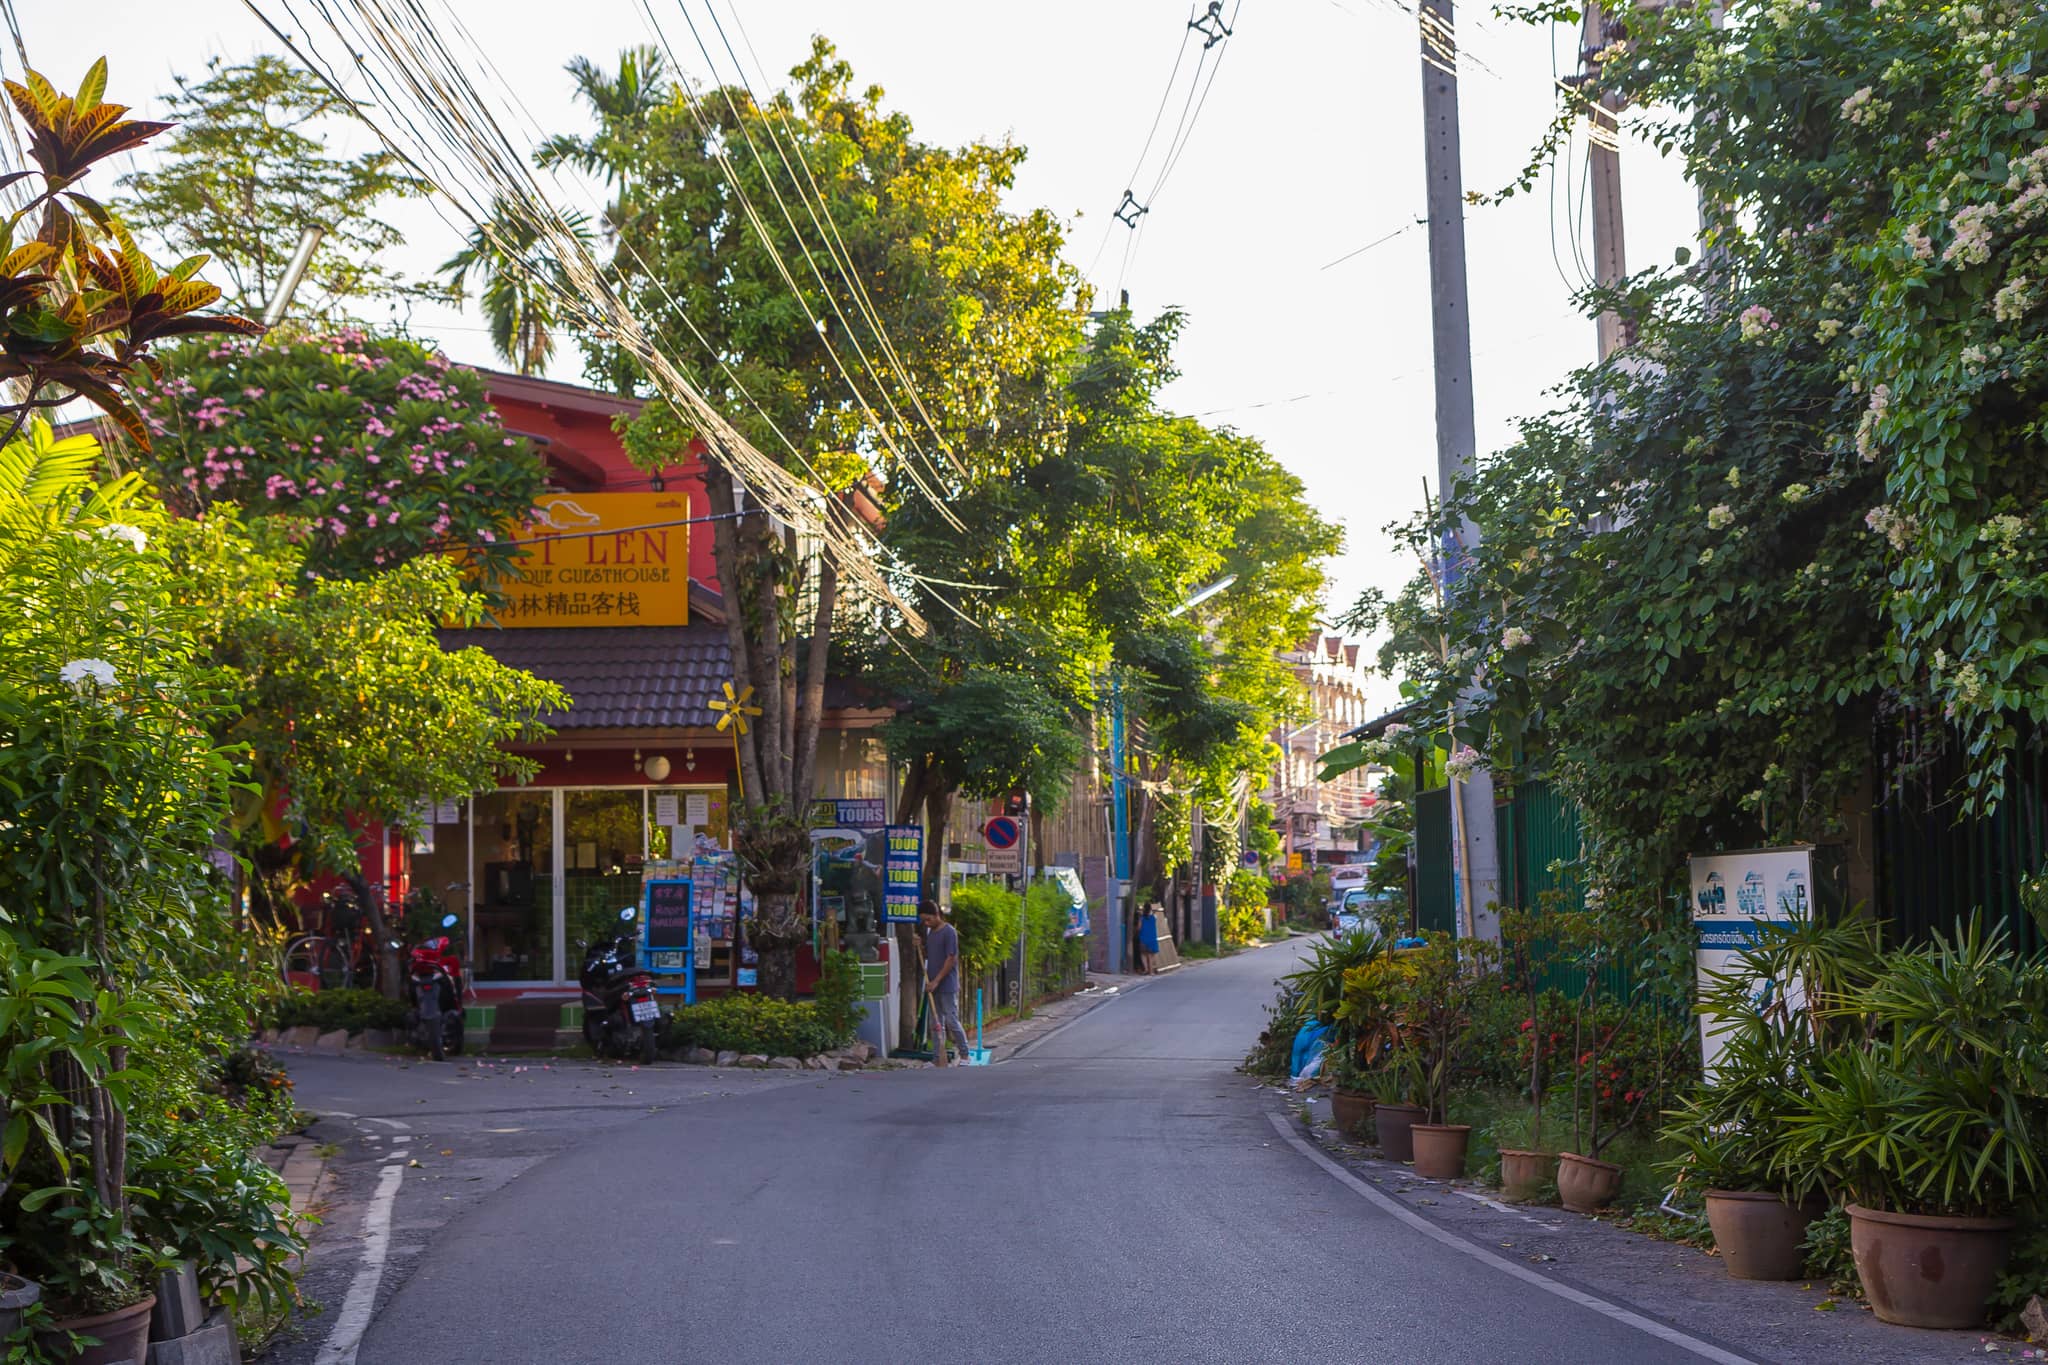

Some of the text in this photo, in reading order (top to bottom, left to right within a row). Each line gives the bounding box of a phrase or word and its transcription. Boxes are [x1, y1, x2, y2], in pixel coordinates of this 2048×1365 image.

[586, 531, 669, 565] LEN
[559, 568, 670, 583] GUESTHOUSE
[838, 808, 884, 822] TOURS
[889, 838, 918, 850] TOUR
[887, 870, 918, 882] TOUR
[886, 904, 917, 916] TOUR
